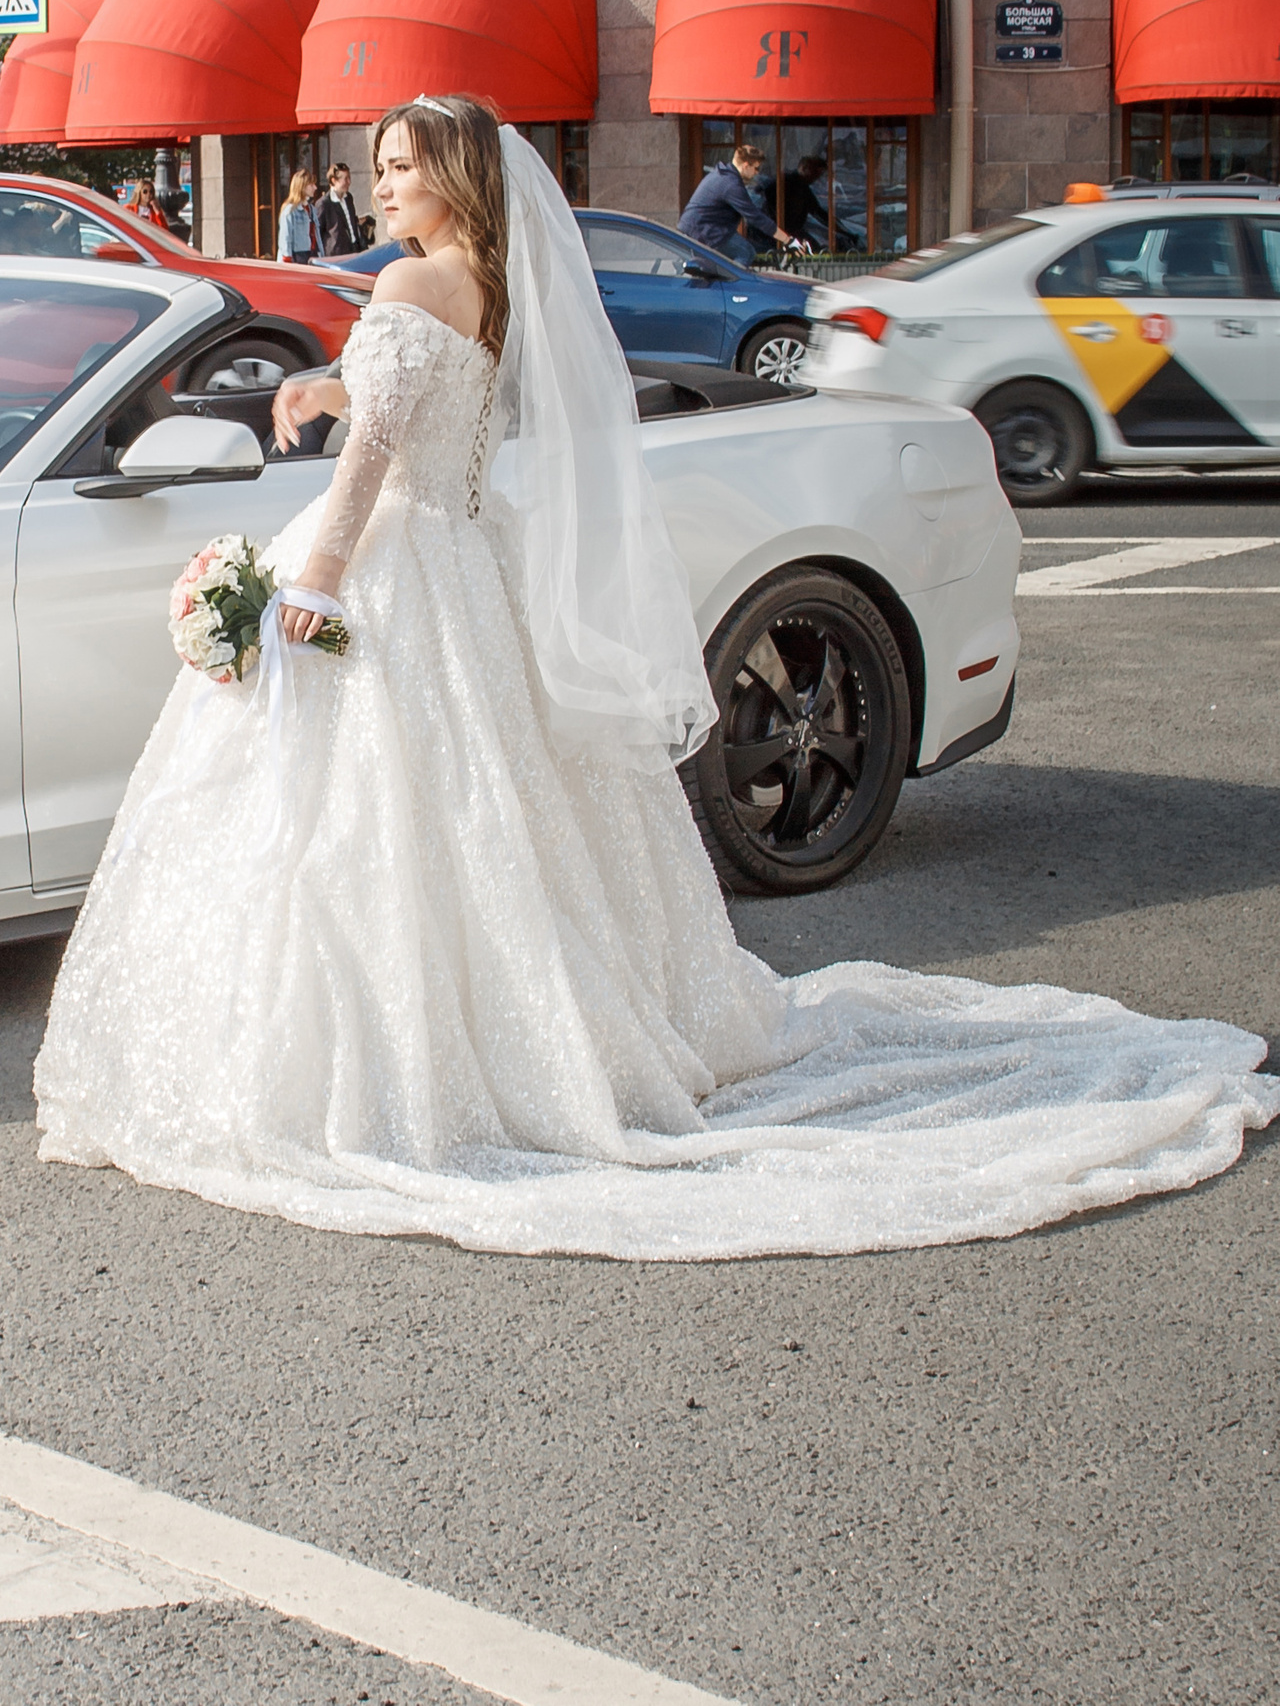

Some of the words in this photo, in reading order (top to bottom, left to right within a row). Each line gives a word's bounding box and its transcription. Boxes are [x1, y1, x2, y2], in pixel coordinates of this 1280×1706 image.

[1005, 7, 1054, 17] БОЛЬШАЯ
[1006, 17, 1052, 26] МОРСКАЯ
[1022, 46, 1036, 59] 39
